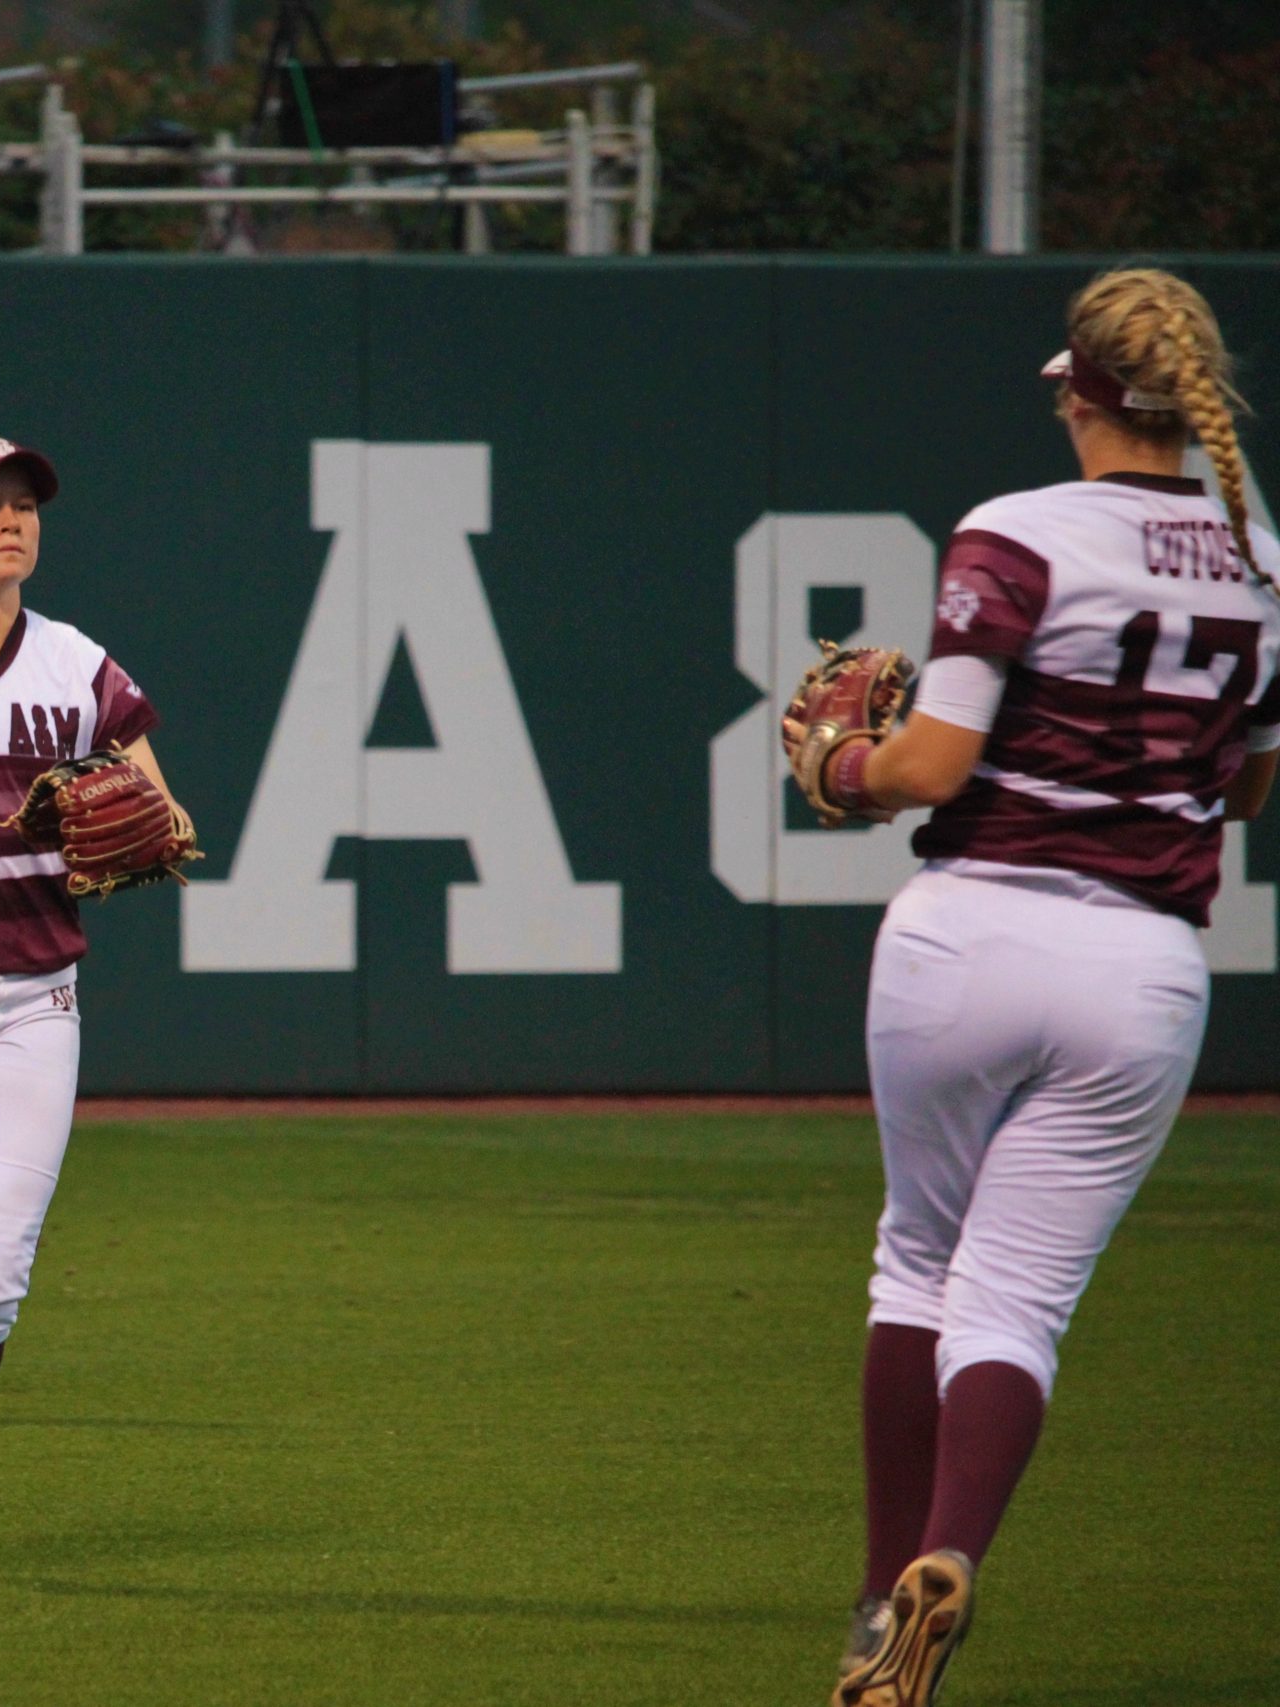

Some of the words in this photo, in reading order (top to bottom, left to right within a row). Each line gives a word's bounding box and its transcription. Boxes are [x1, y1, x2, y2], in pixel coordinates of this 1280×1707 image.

[1108, 608, 1264, 768] 17
[8, 702, 81, 760] A&M
[78, 772, 139, 802] LOUISVILLE
